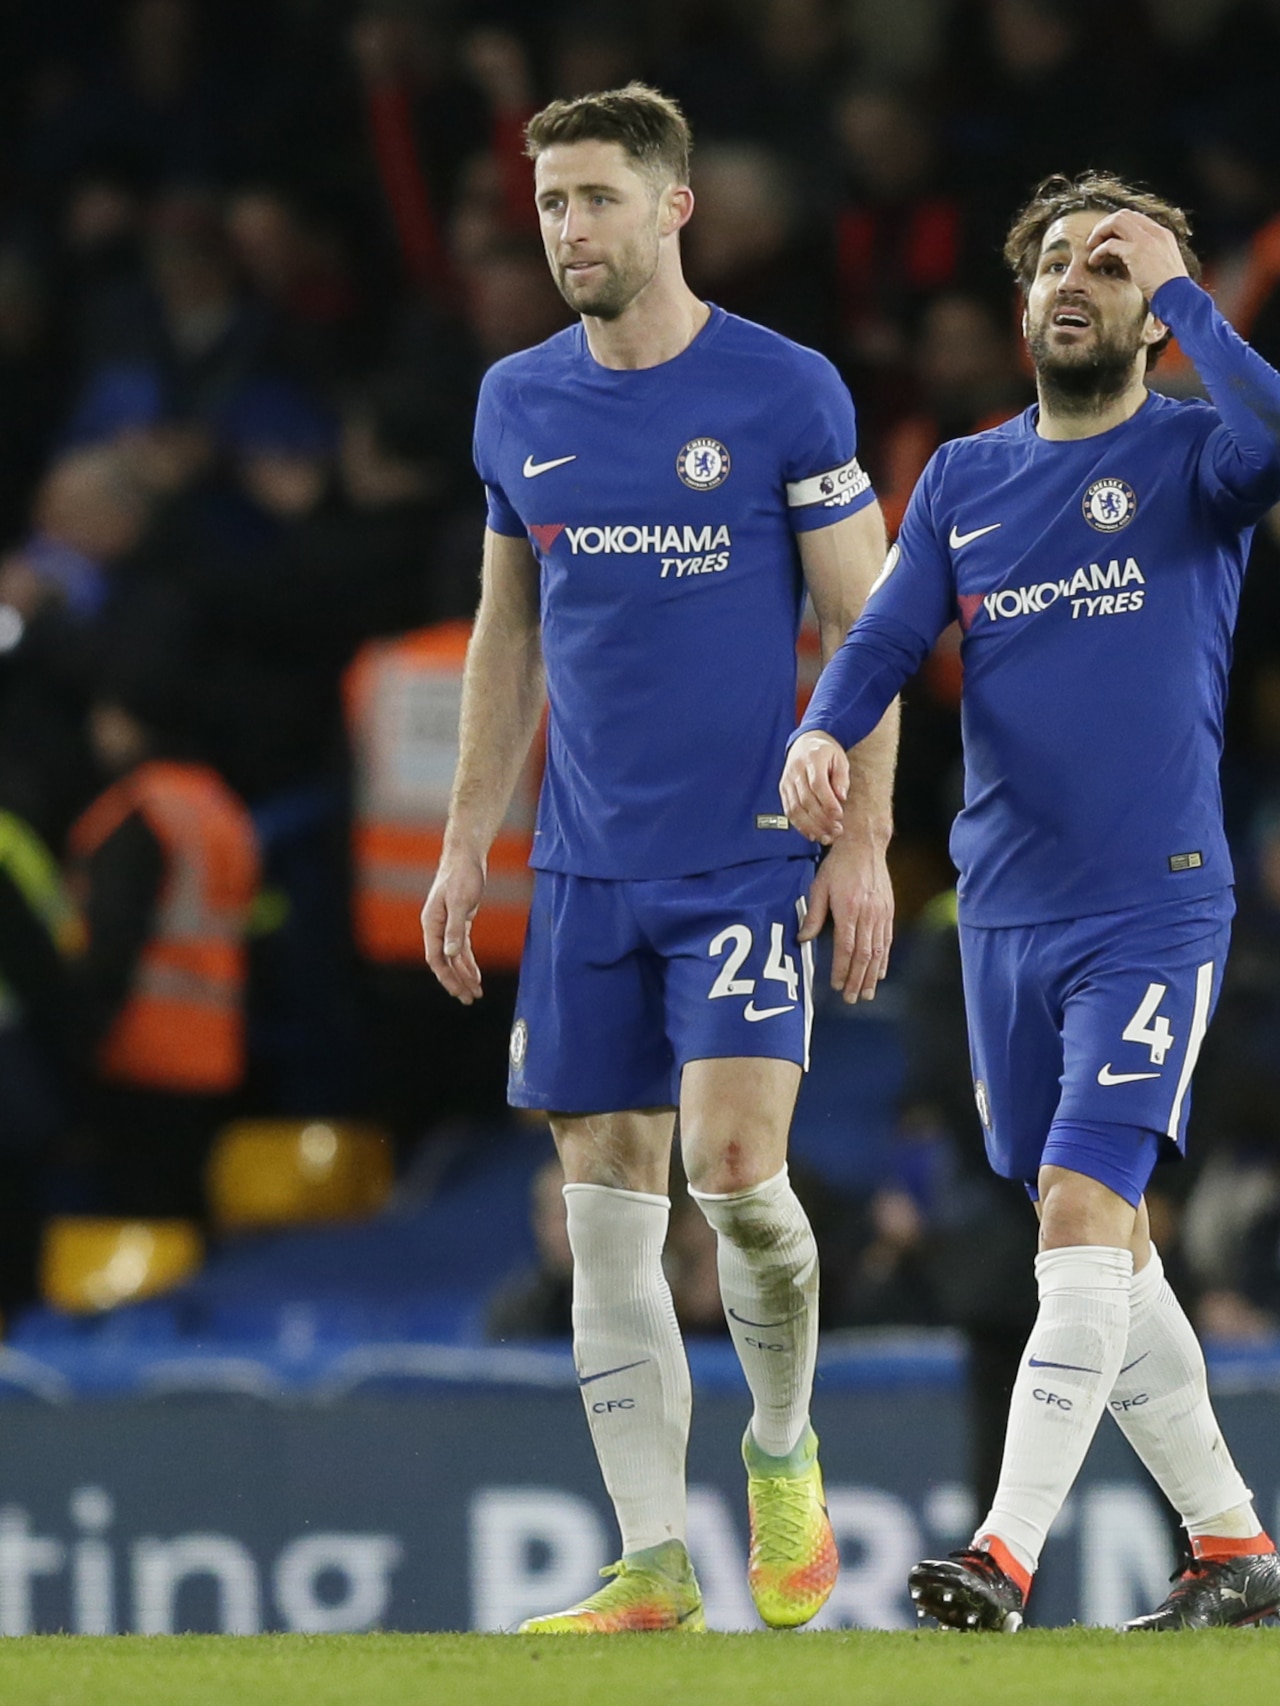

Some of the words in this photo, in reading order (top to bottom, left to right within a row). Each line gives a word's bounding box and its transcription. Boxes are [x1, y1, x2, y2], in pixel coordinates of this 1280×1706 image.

[564, 524, 731, 555] YOKOHAMA
[660, 551, 730, 579] TYRES
[1070, 590, 1146, 620] TYRES
[707, 922, 799, 1001] 24
[1122, 982, 1175, 1066] 4
[592, 1398, 635, 1414] CFC
[1032, 1388, 1073, 1411] CFC
[1110, 1393, 1150, 1412] CFC
